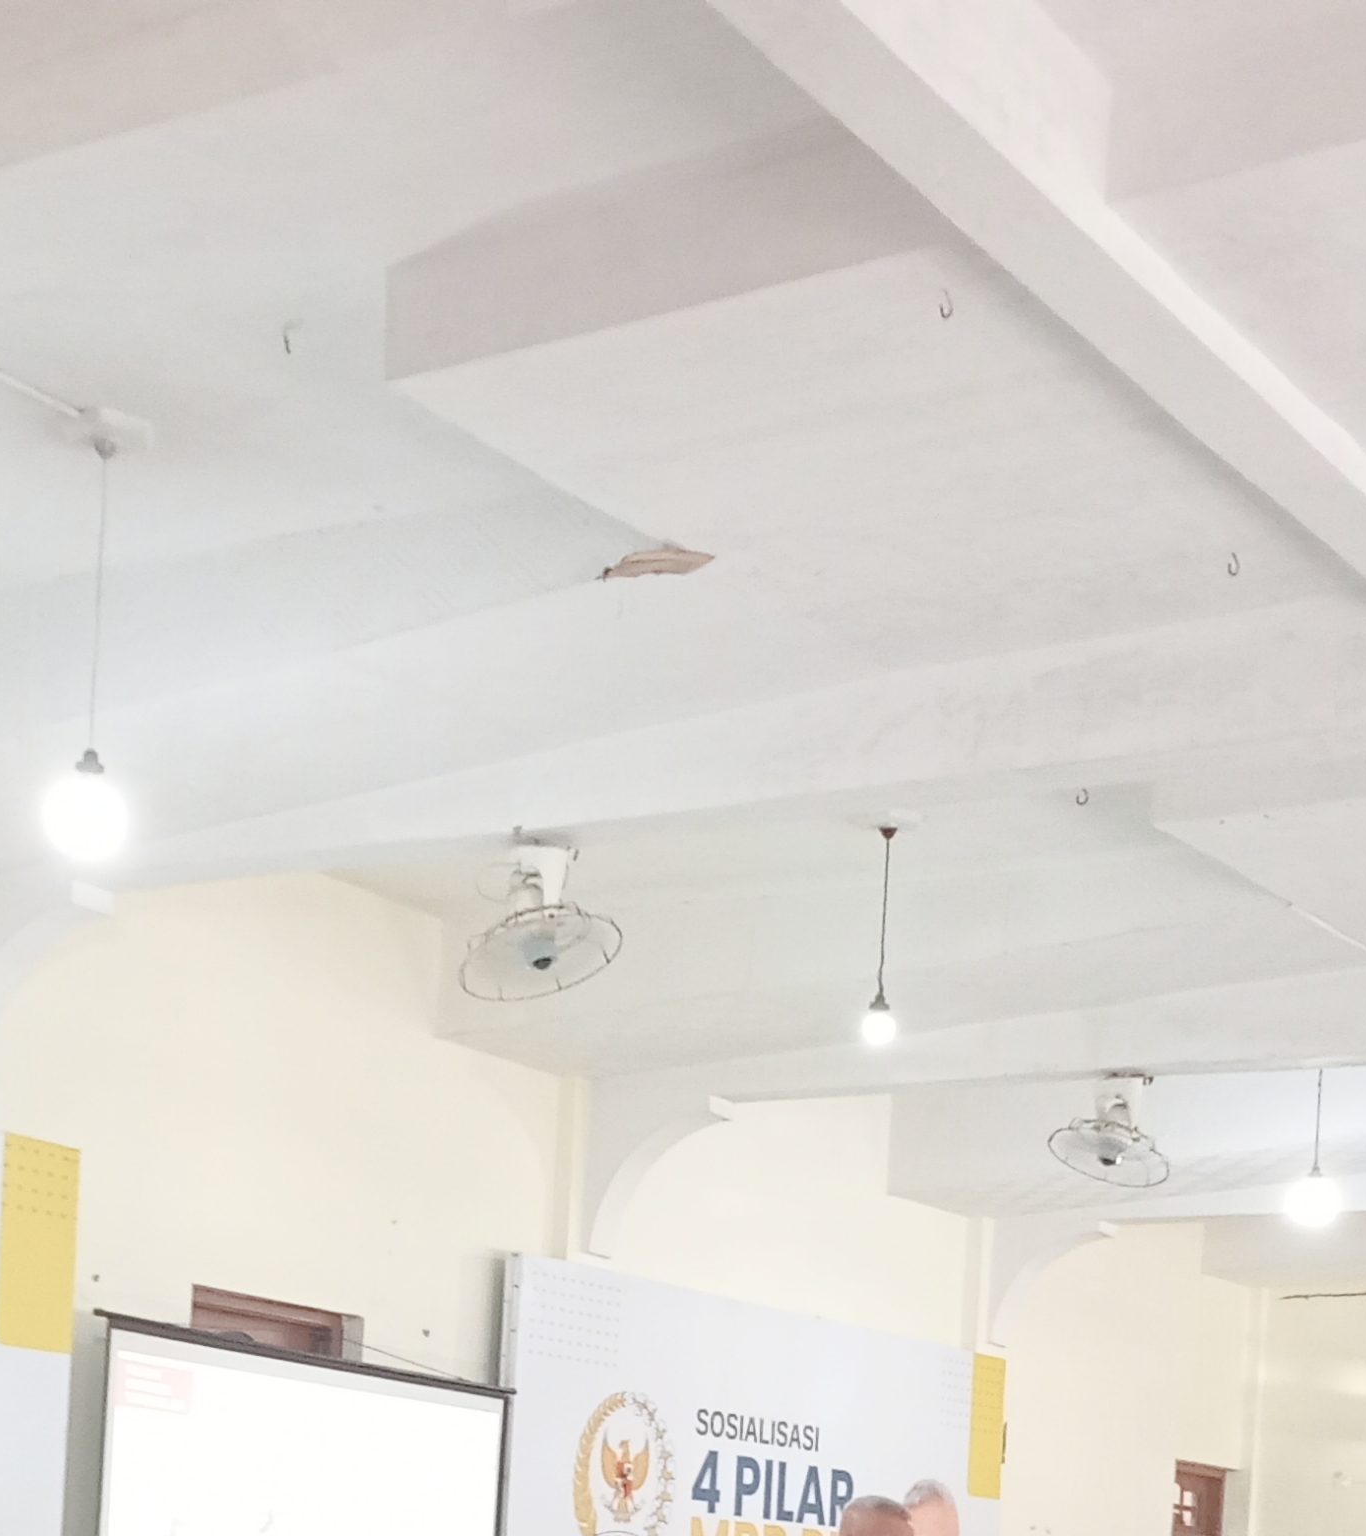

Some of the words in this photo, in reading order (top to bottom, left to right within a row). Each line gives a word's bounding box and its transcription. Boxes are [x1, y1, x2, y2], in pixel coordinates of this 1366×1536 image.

[695, 1407, 821, 1453] SOSIALISASI
[691, 1449, 721, 1514] 4
[733, 1454, 855, 1528] PILAR
